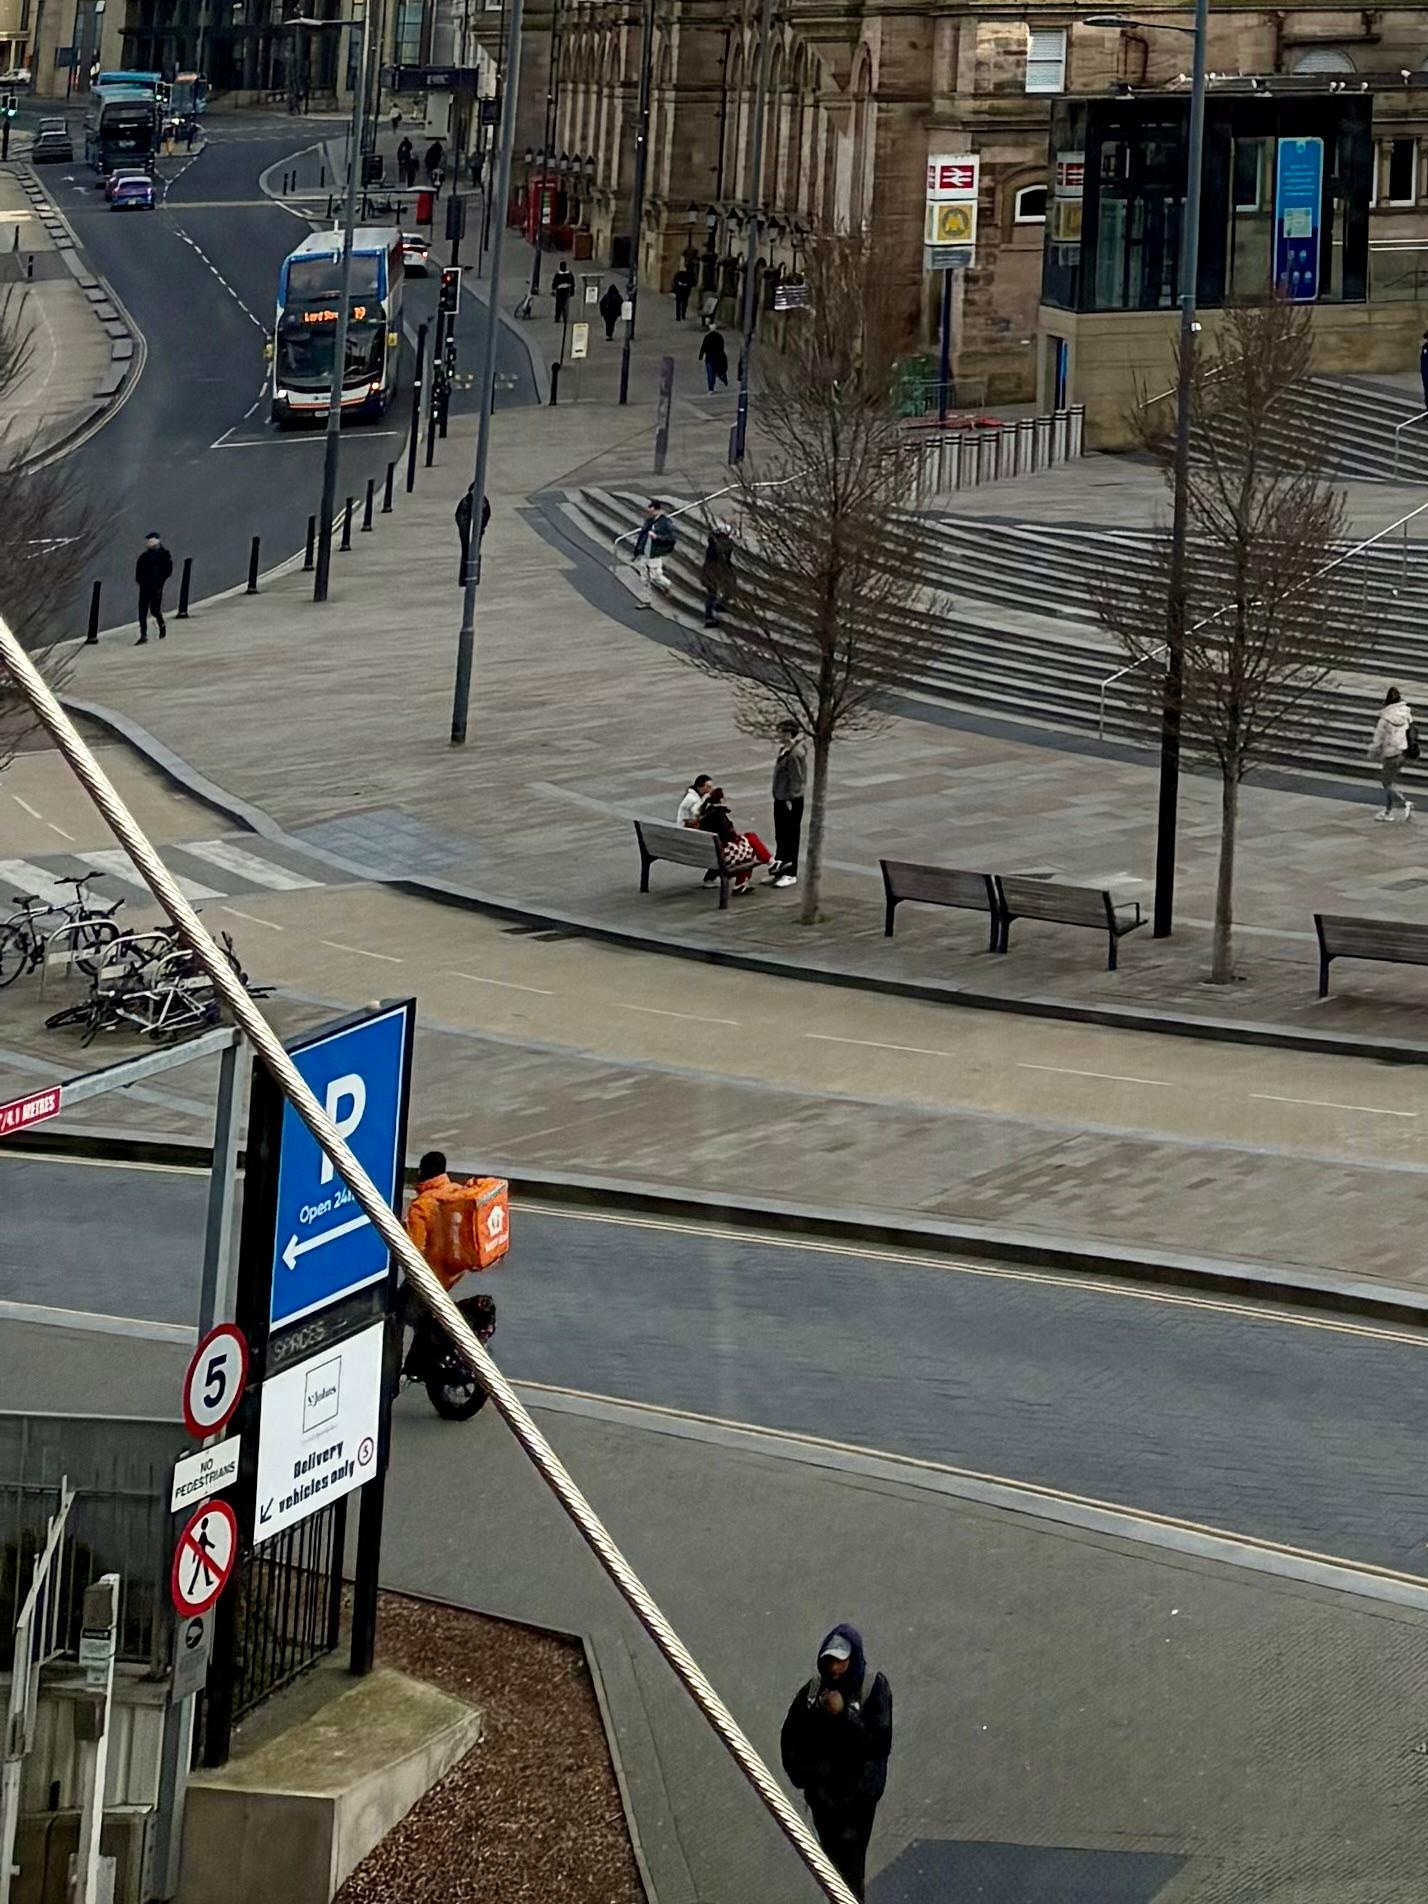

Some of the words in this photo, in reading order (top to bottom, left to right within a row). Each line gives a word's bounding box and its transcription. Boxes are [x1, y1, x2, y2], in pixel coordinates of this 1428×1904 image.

[22, 1093, 56, 1123] METRES
[320, 1073, 367, 1185] P
[299, 1199, 332, 1225] Open
[203, 1353, 228, 1409] 5
[200, 1458, 214, 1473] NO
[293, 1441, 344, 1479] Delivery
[175, 1461, 236, 1499] PEDESTRIANS
[279, 1475, 328, 1514] vehicles
[330, 1459, 355, 1485] only
